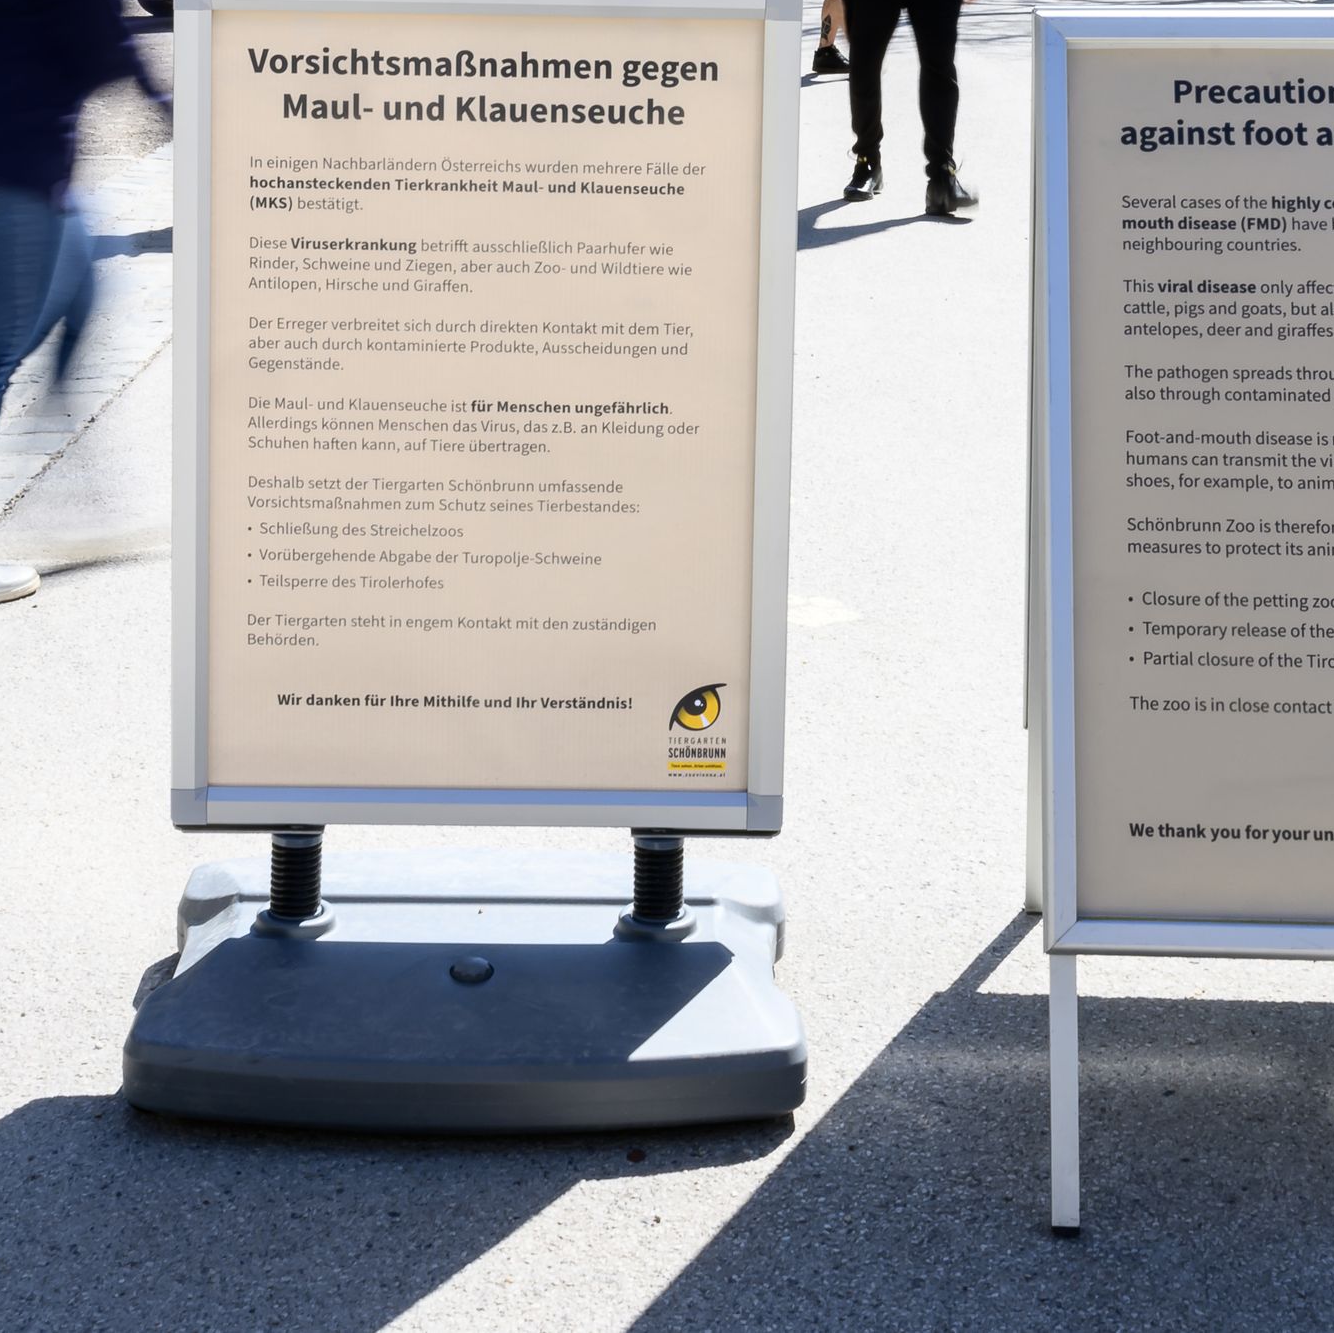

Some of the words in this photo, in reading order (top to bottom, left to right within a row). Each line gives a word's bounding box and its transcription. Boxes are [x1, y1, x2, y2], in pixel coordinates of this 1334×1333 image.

[247, 46, 612, 79] Vorsichtsmaßnahmen
[621, 59, 718, 88] gegen
[283, 92, 373, 120] Maul-
[383, 94, 445, 121] und
[455, 94, 685, 125] Klauenseuche
[1120, 118, 1235, 152] against
[1242, 118, 1308, 146] foot
[249, 155, 262, 168] In
[265, 155, 318, 173] einigen
[322, 156, 437, 171] Nachbarländern
[440, 155, 521, 173] Österreichs
[524, 159, 578, 174] wurden
[582, 160, 642, 175] mehrere
[645, 161, 679, 175] Fälle
[681, 161, 706, 175] der
[249, 174, 390, 190] hochansteckenden
[394, 177, 498, 192] Tierkrankheit
[502, 179, 543, 193] Maul-
[547, 180, 576, 193] und
[580, 180, 685, 195] Klauenseuche
[249, 194, 293, 212] (MKS)
[297, 196, 363, 214] bestätigt.
[1121, 194, 1176, 209] Several
[1179, 197, 1221, 209] cases
[1224, 194, 1240, 209] of
[1242, 194, 1267, 209] the
[1271, 194, 1321, 213] highly
[1121, 215, 1174, 229] mouth
[1177, 215, 1236, 230] disease
[1240, 215, 1287, 233] (FMD)
[1291, 216, 1327, 230] have
[249, 235, 287, 249] Diese
[289, 235, 417, 255] Viruserkrankung
[420, 238, 468, 252] betrifft
[471, 239, 572, 254] ausschließlich
[576, 241, 645, 255] Paarhufer
[648, 242, 673, 256] wie
[1122, 235, 1223, 255] neighbouring
[1226, 237, 1301, 252] countries.
[1122, 278, 1154, 293] This
[1156, 278, 1193, 293] viral
[1196, 278, 1256, 294] disease
[1259, 279, 1293, 297] only
[248, 396, 270, 409] Die
[274, 396, 313, 410] Maul-
[317, 397, 344, 410] und
[348, 397, 447, 412] Klauenseuche
[450, 399, 467, 412] ist
[470, 399, 493, 413] für
[496, 400, 571, 413] Menschen
[574, 400, 673, 417] ungefährlich.
[1125, 429, 1251, 445] Foot-and-mouth
[1254, 430, 1313, 446] disease
[1316, 431, 1329, 446] is
[246, 494, 401, 510] Vorsichtsmaßnahmen
[404, 499, 435, 511] zum
[438, 497, 486, 512] Schutz
[489, 498, 533, 512] seines
[536, 498, 640, 513] Tierbestandes:
[259, 521, 339, 539] Schließung
[341, 522, 366, 536] des
[369, 522, 464, 537] Streichelzoos
[258, 547, 376, 565] Vorübergehende
[378, 548, 432, 566] Abgabe
[434, 549, 459, 563] der
[461, 550, 602, 567] Turopolje-Schweine
[1141, 590, 1201, 606] Closure
[1204, 591, 1220, 606] of
[1222, 591, 1249, 607] the
[1252, 592, 1309, 612] petting
[1141, 620, 1227, 640] Temporary
[1231, 621, 1287, 637] release
[1289, 622, 1307, 638] of
[1308, 622, 1334, 639] the
[1143, 650, 1193, 666] Partial
[1197, 651, 1254, 667] closure
[1257, 651, 1274, 667] of
[1276, 652, 1303, 668] the
[276, 692, 302, 705] Wir
[305, 693, 360, 706] danken
[363, 693, 386, 707] für
[389, 694, 419, 707] Ihre
[423, 694, 480, 708] Mithilfe
[483, 695, 512, 708] und
[515, 695, 537, 708] Ihr
[539, 696, 632, 709] Verständnis!
[668, 737, 727, 745] TIERGARTEN
[668, 745, 727, 759] SCHÖNBRUNN
[1128, 822, 1154, 837] We
[1157, 822, 1206, 838] thank
[1209, 827, 1241, 842] you
[1244, 824, 1269, 840] for
[1271, 828, 1310, 844] your
